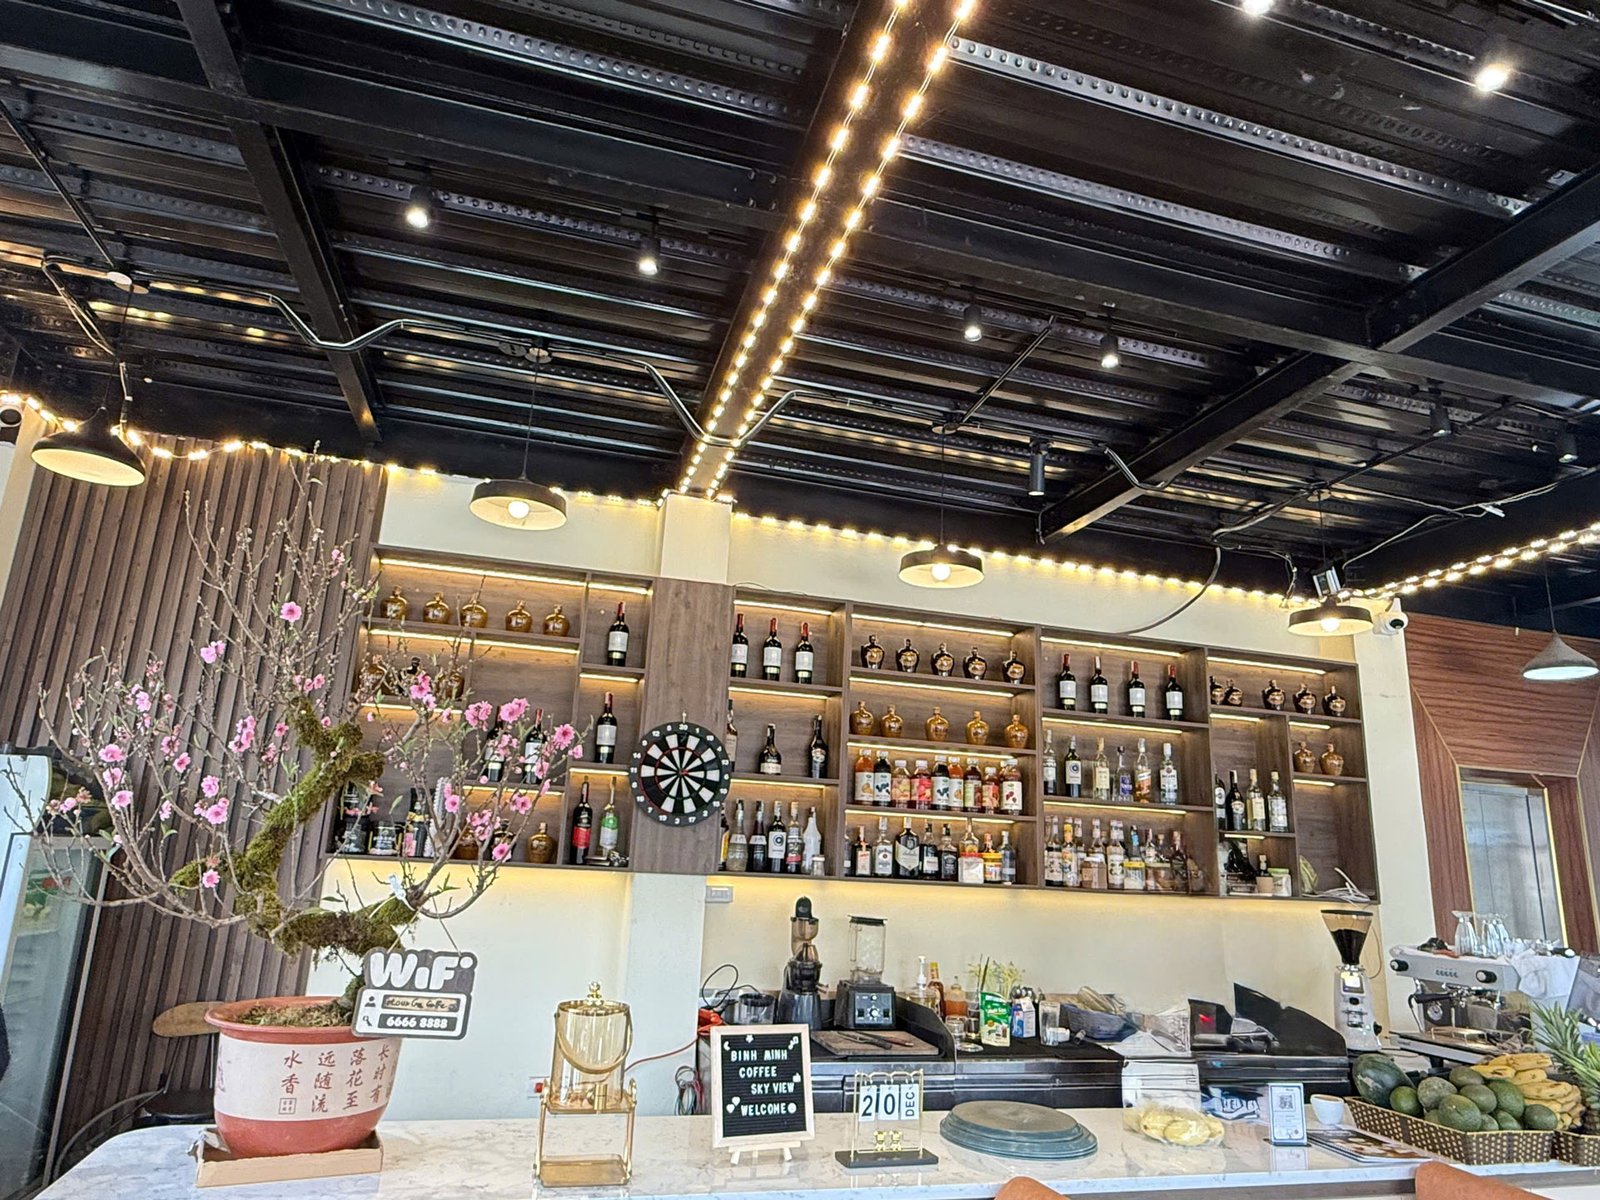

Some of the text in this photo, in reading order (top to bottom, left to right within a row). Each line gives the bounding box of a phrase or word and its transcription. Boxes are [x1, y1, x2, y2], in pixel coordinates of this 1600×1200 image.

[386, 1016, 448, 1029] 6666 8888
[730, 1049, 788, 1062] BINH MINH
[281, 1049, 303, 1095] 水香
[342, 1047, 367, 1111] 落花至
[739, 1066, 777, 1079] COFFEE
[311, 1050, 336, 1113] 远随流
[751, 1082, 794, 1095] SKY VIEW
[740, 1102, 787, 1117] WELCOME
[904, 1091, 915, 1117] DEC
